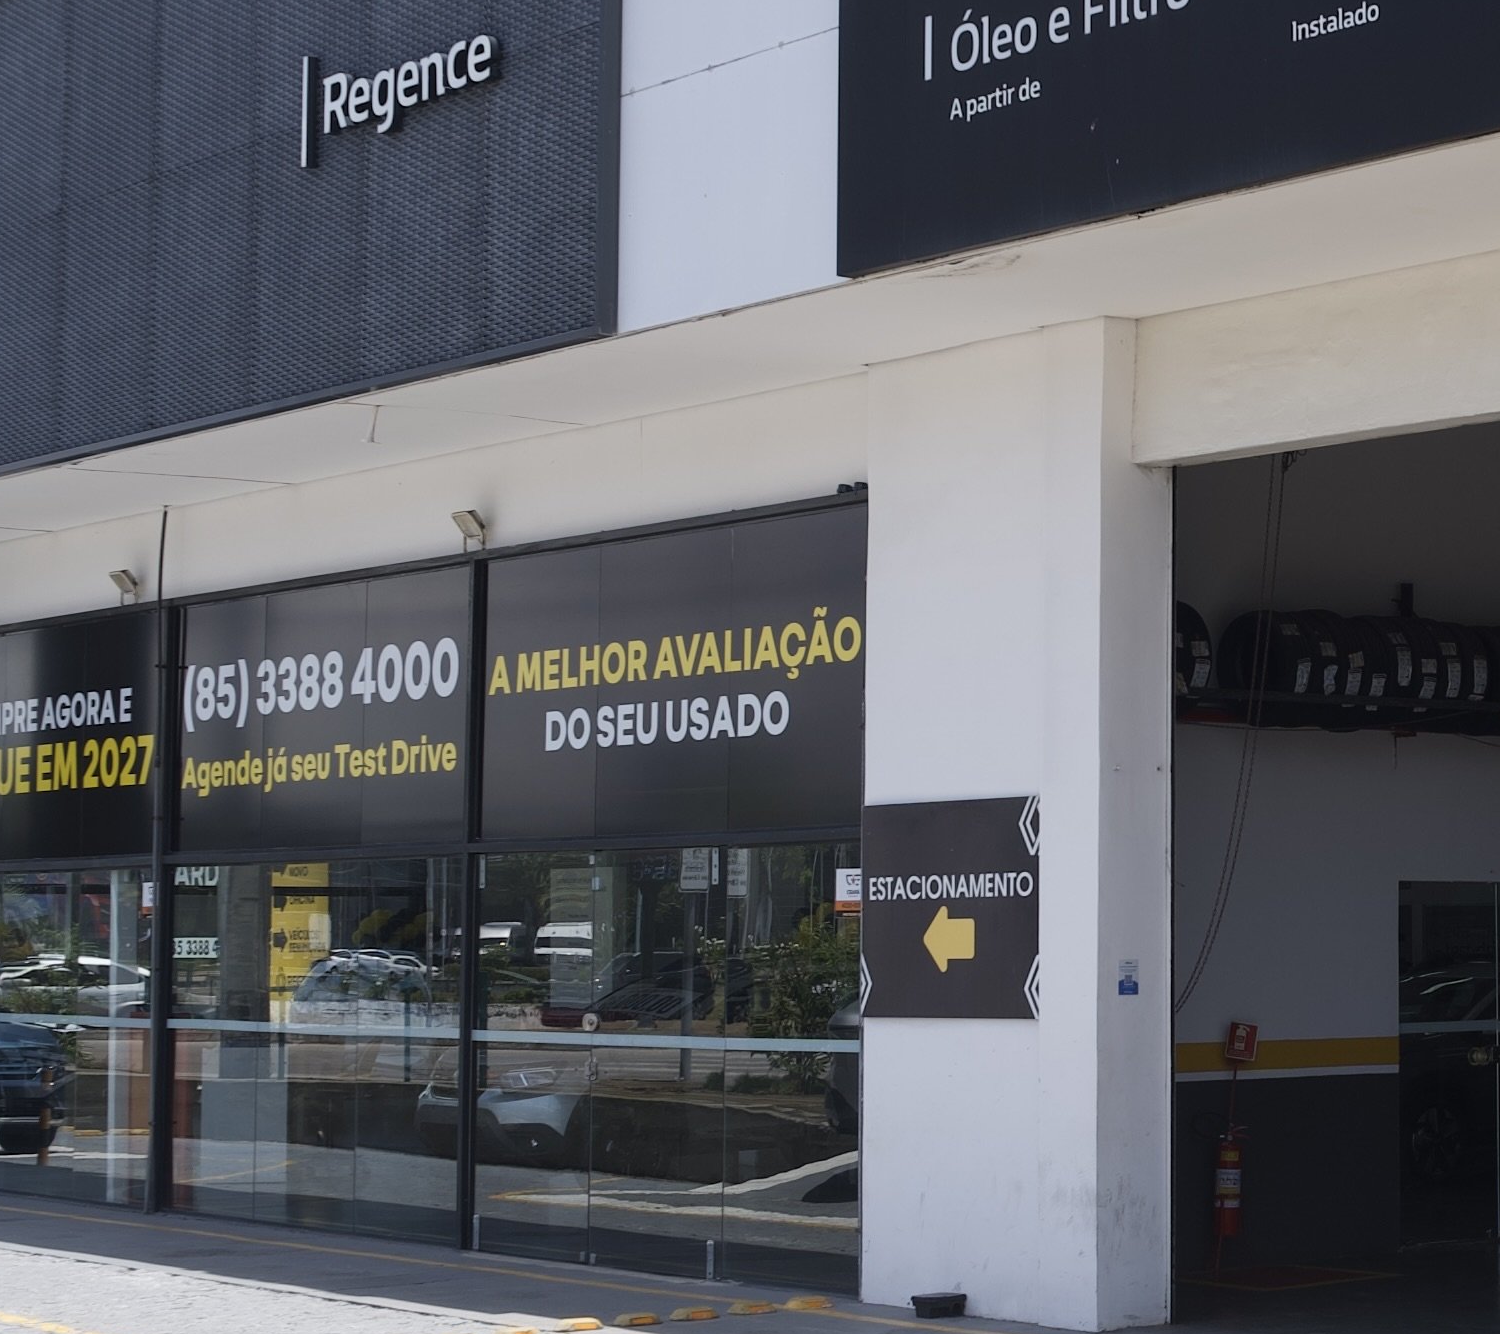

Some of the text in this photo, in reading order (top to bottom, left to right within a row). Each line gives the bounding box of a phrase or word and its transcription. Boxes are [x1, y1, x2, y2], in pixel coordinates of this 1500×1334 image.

[950, 10, 1037, 72] Óleo
[1048, 5, 1070, 45] e
[1291, 0, 1380, 42] Instalado
[323, 34, 492, 134] Regence
[949, 77, 1041, 121] A partir de
[488, 606, 861, 695] A MELHOR AVALIAÇÃO
[40, 690, 116, 730] AGORA
[118, 687, 133, 723] E
[182, 637, 460, 733] (85) 3388 4000
[545, 690, 790, 752] DO SEU USADO
[35, 741, 78, 792] EM
[83, 734, 155, 788] 2027
[181, 735, 457, 797] Agende já seu Test Drive
[868, 871, 1034, 901] ESTACIONAMENTO
